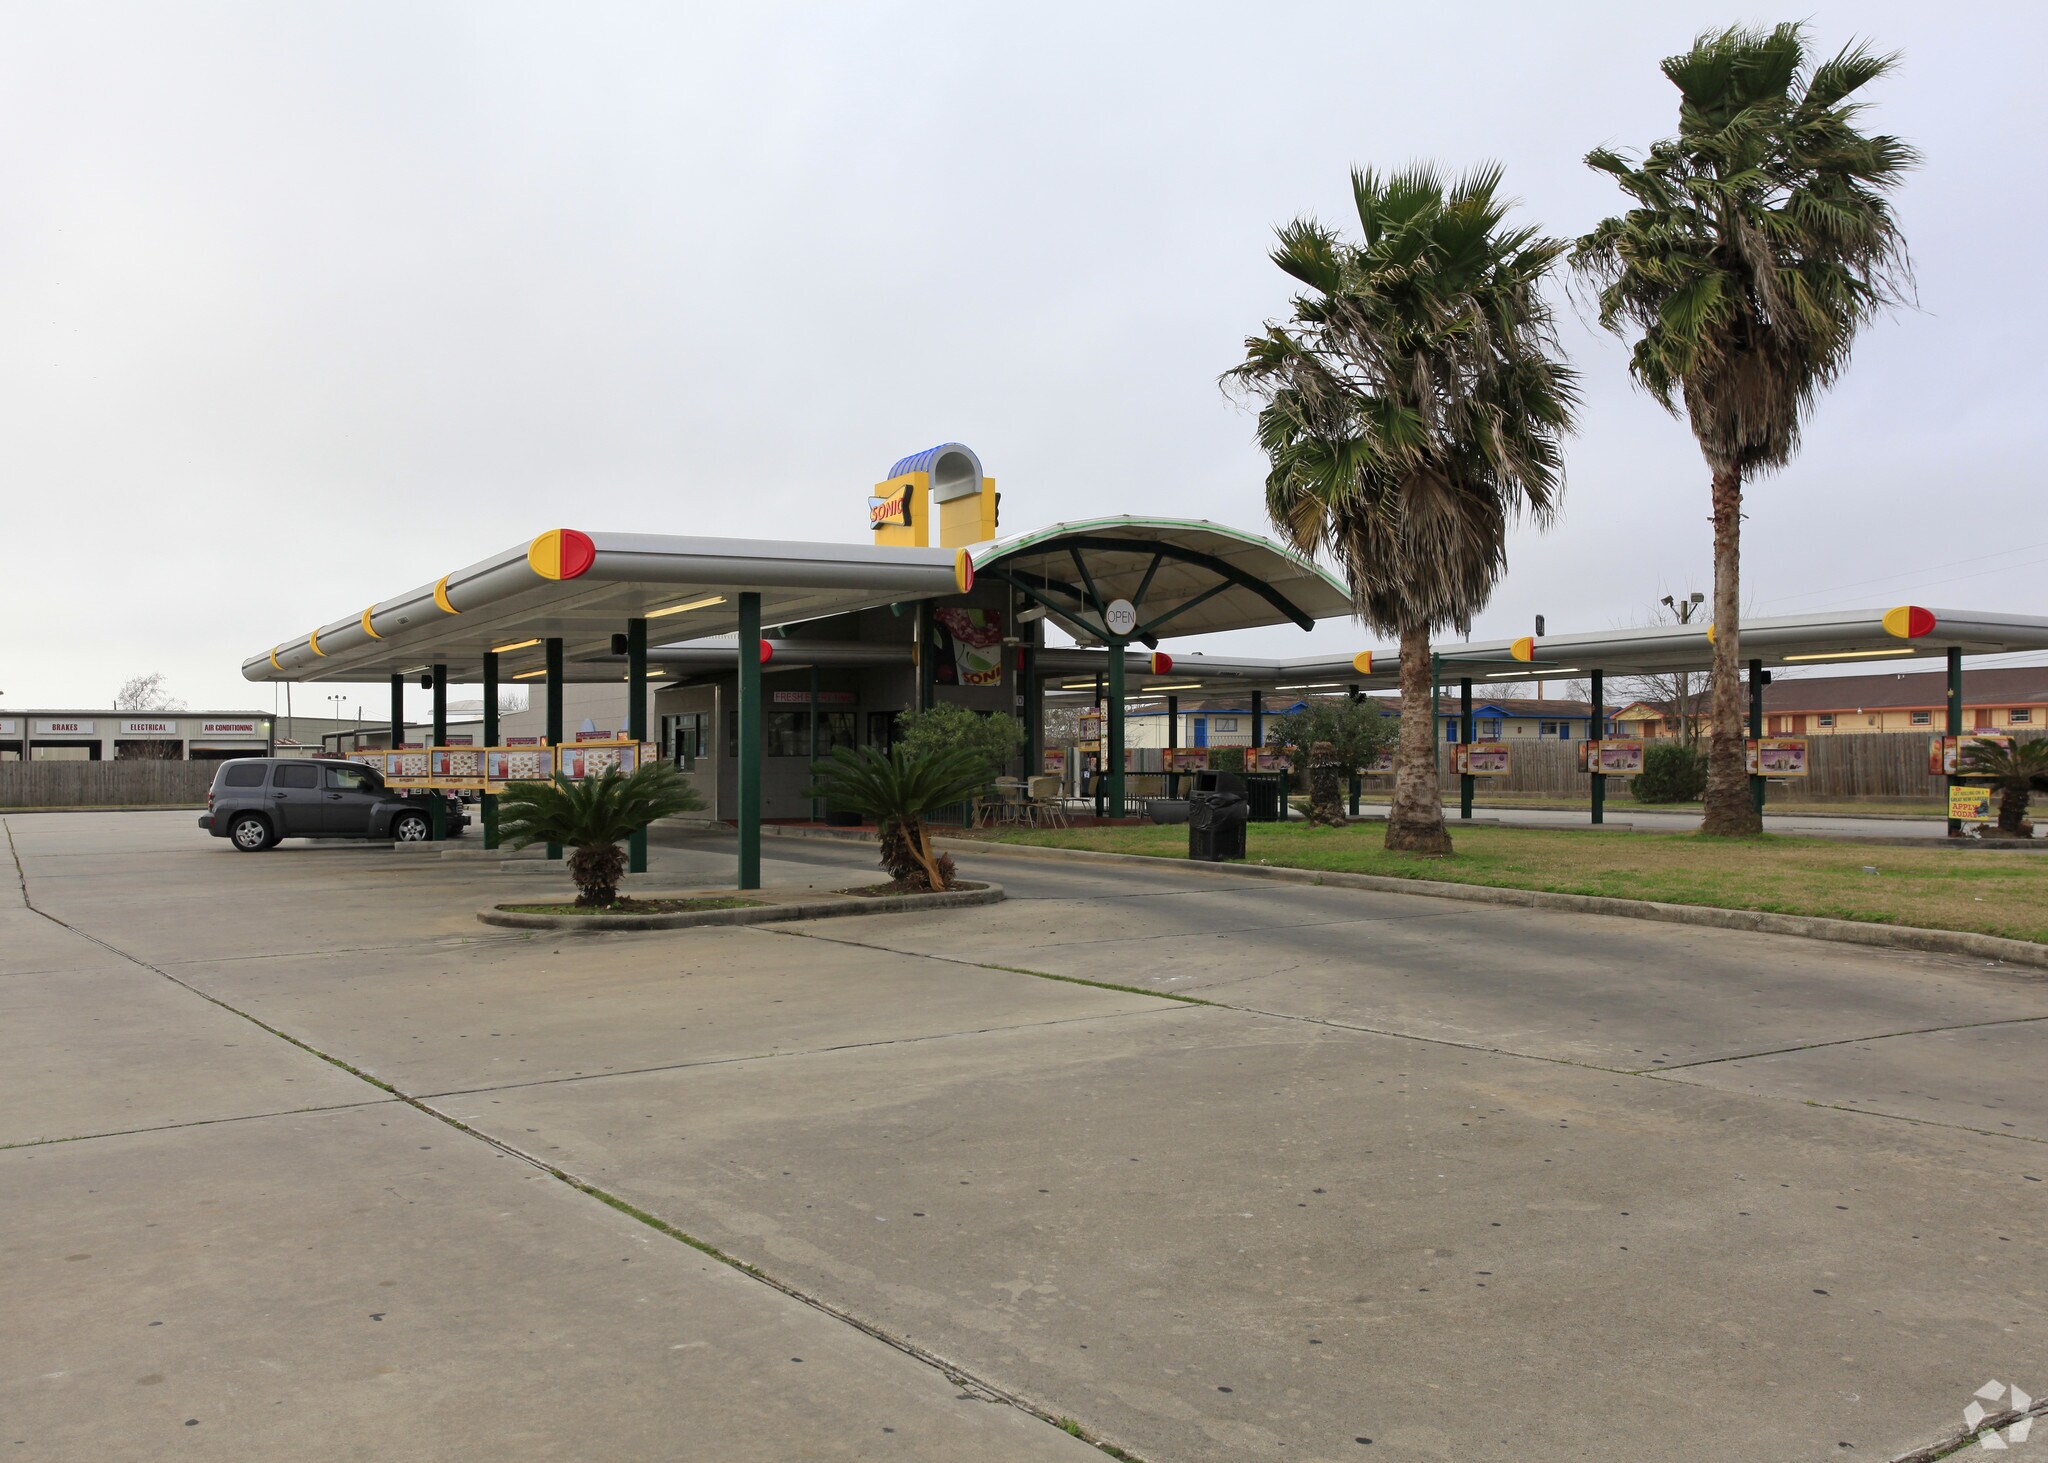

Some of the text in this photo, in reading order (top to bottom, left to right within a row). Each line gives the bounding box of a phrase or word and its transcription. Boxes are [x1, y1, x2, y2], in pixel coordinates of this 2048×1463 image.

[871, 497, 905, 522] SONIC
[1108, 610, 1135, 624] OPEN
[775, 692, 802, 702] FRESH
[216, 724, 253, 732] CONDITIONING
[1952, 803, 1978, 811] APPLY
[1952, 810, 1978, 818] TODAY
